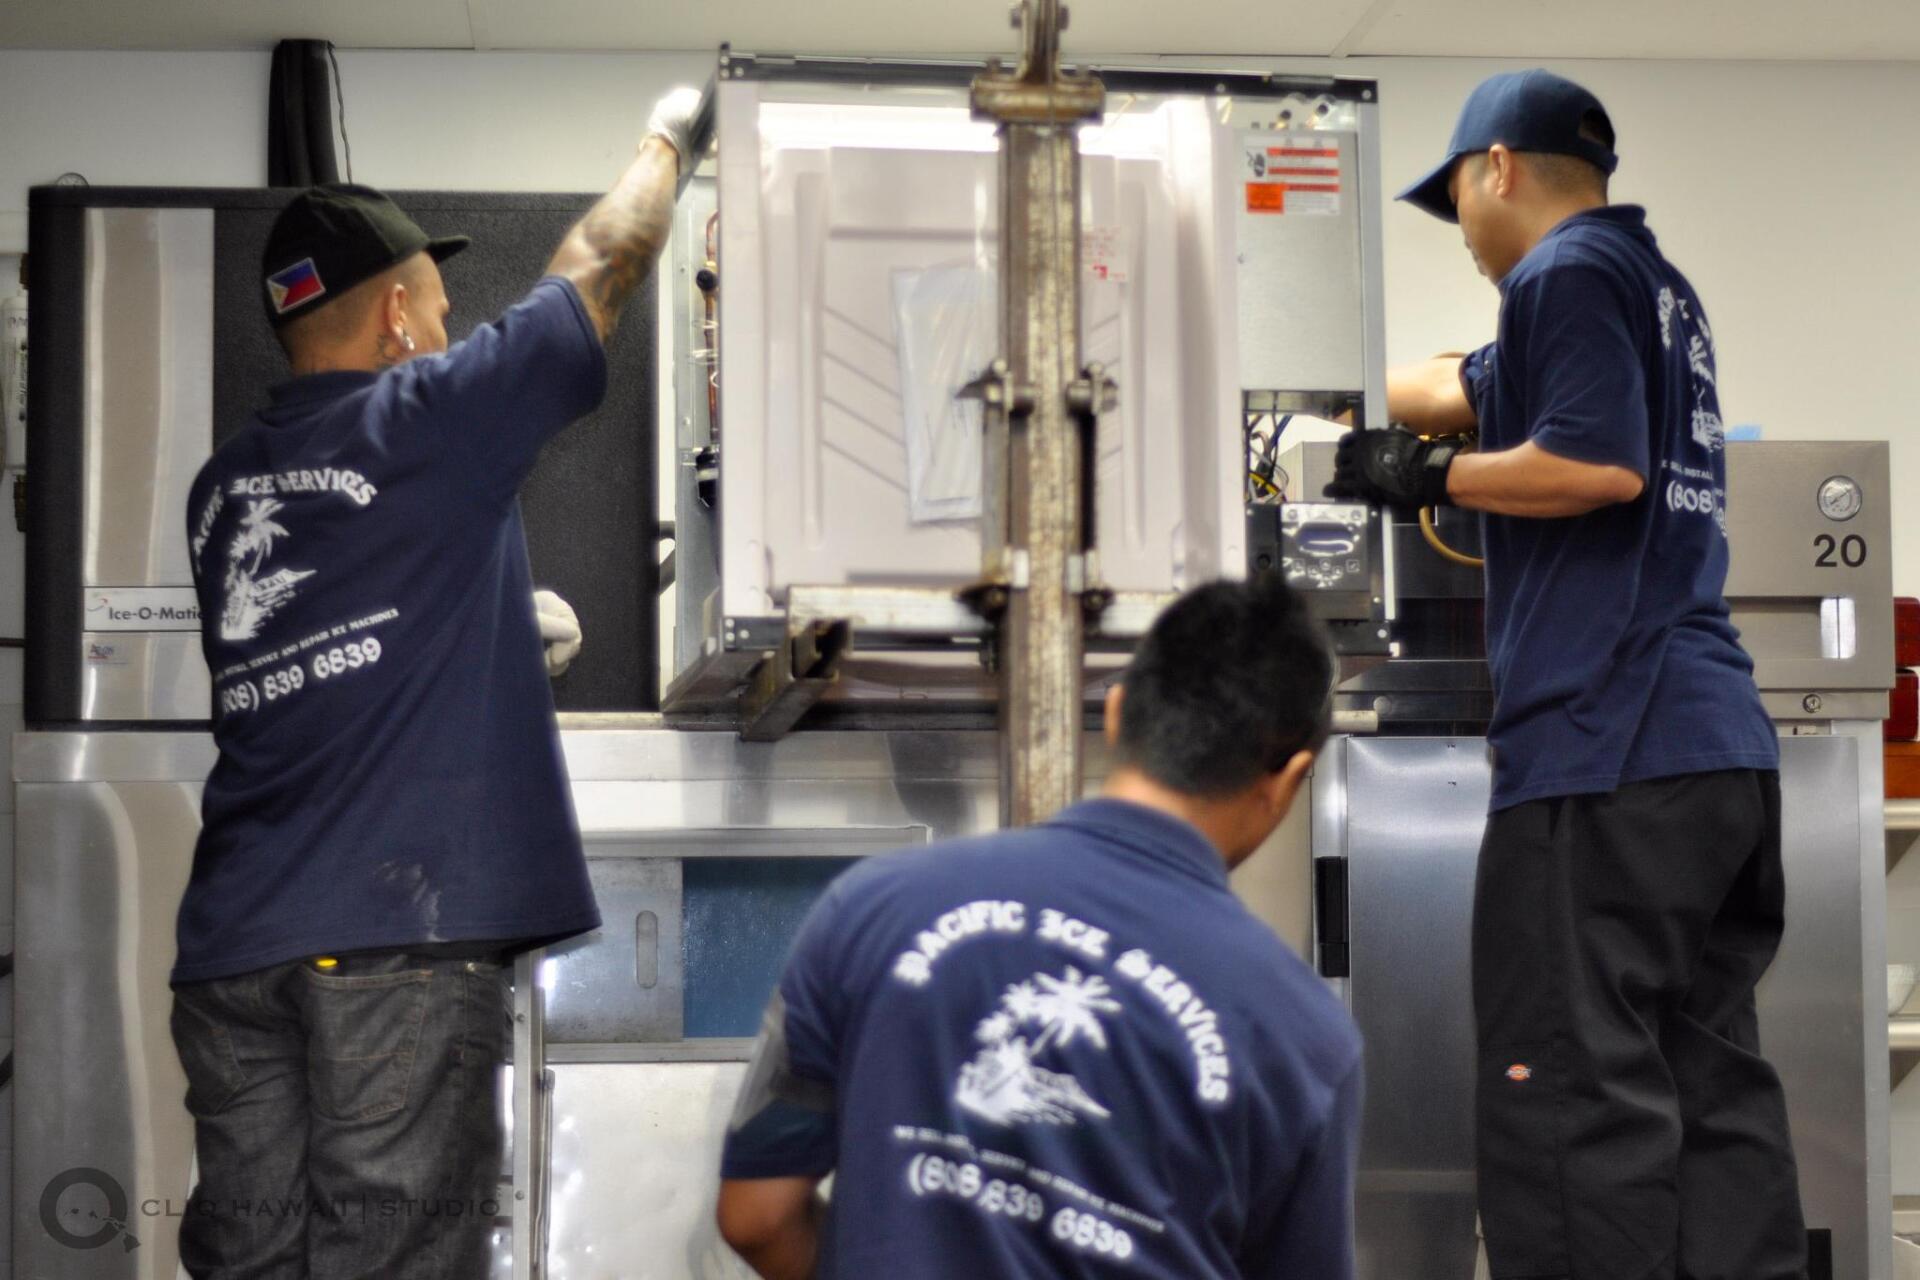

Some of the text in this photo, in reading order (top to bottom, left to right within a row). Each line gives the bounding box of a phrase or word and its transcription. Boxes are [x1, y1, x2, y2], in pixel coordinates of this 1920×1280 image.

[1813, 533, 1867, 567] 20
[349, 607, 399, 631] MACHINES
[263, 664, 305, 700] 839
[313, 636, 382, 679] 6839
[893, 899, 1026, 986] PACIFIC
[1113, 948, 1230, 1103] SERVICES
[1052, 1206, 1134, 1259] 6839
